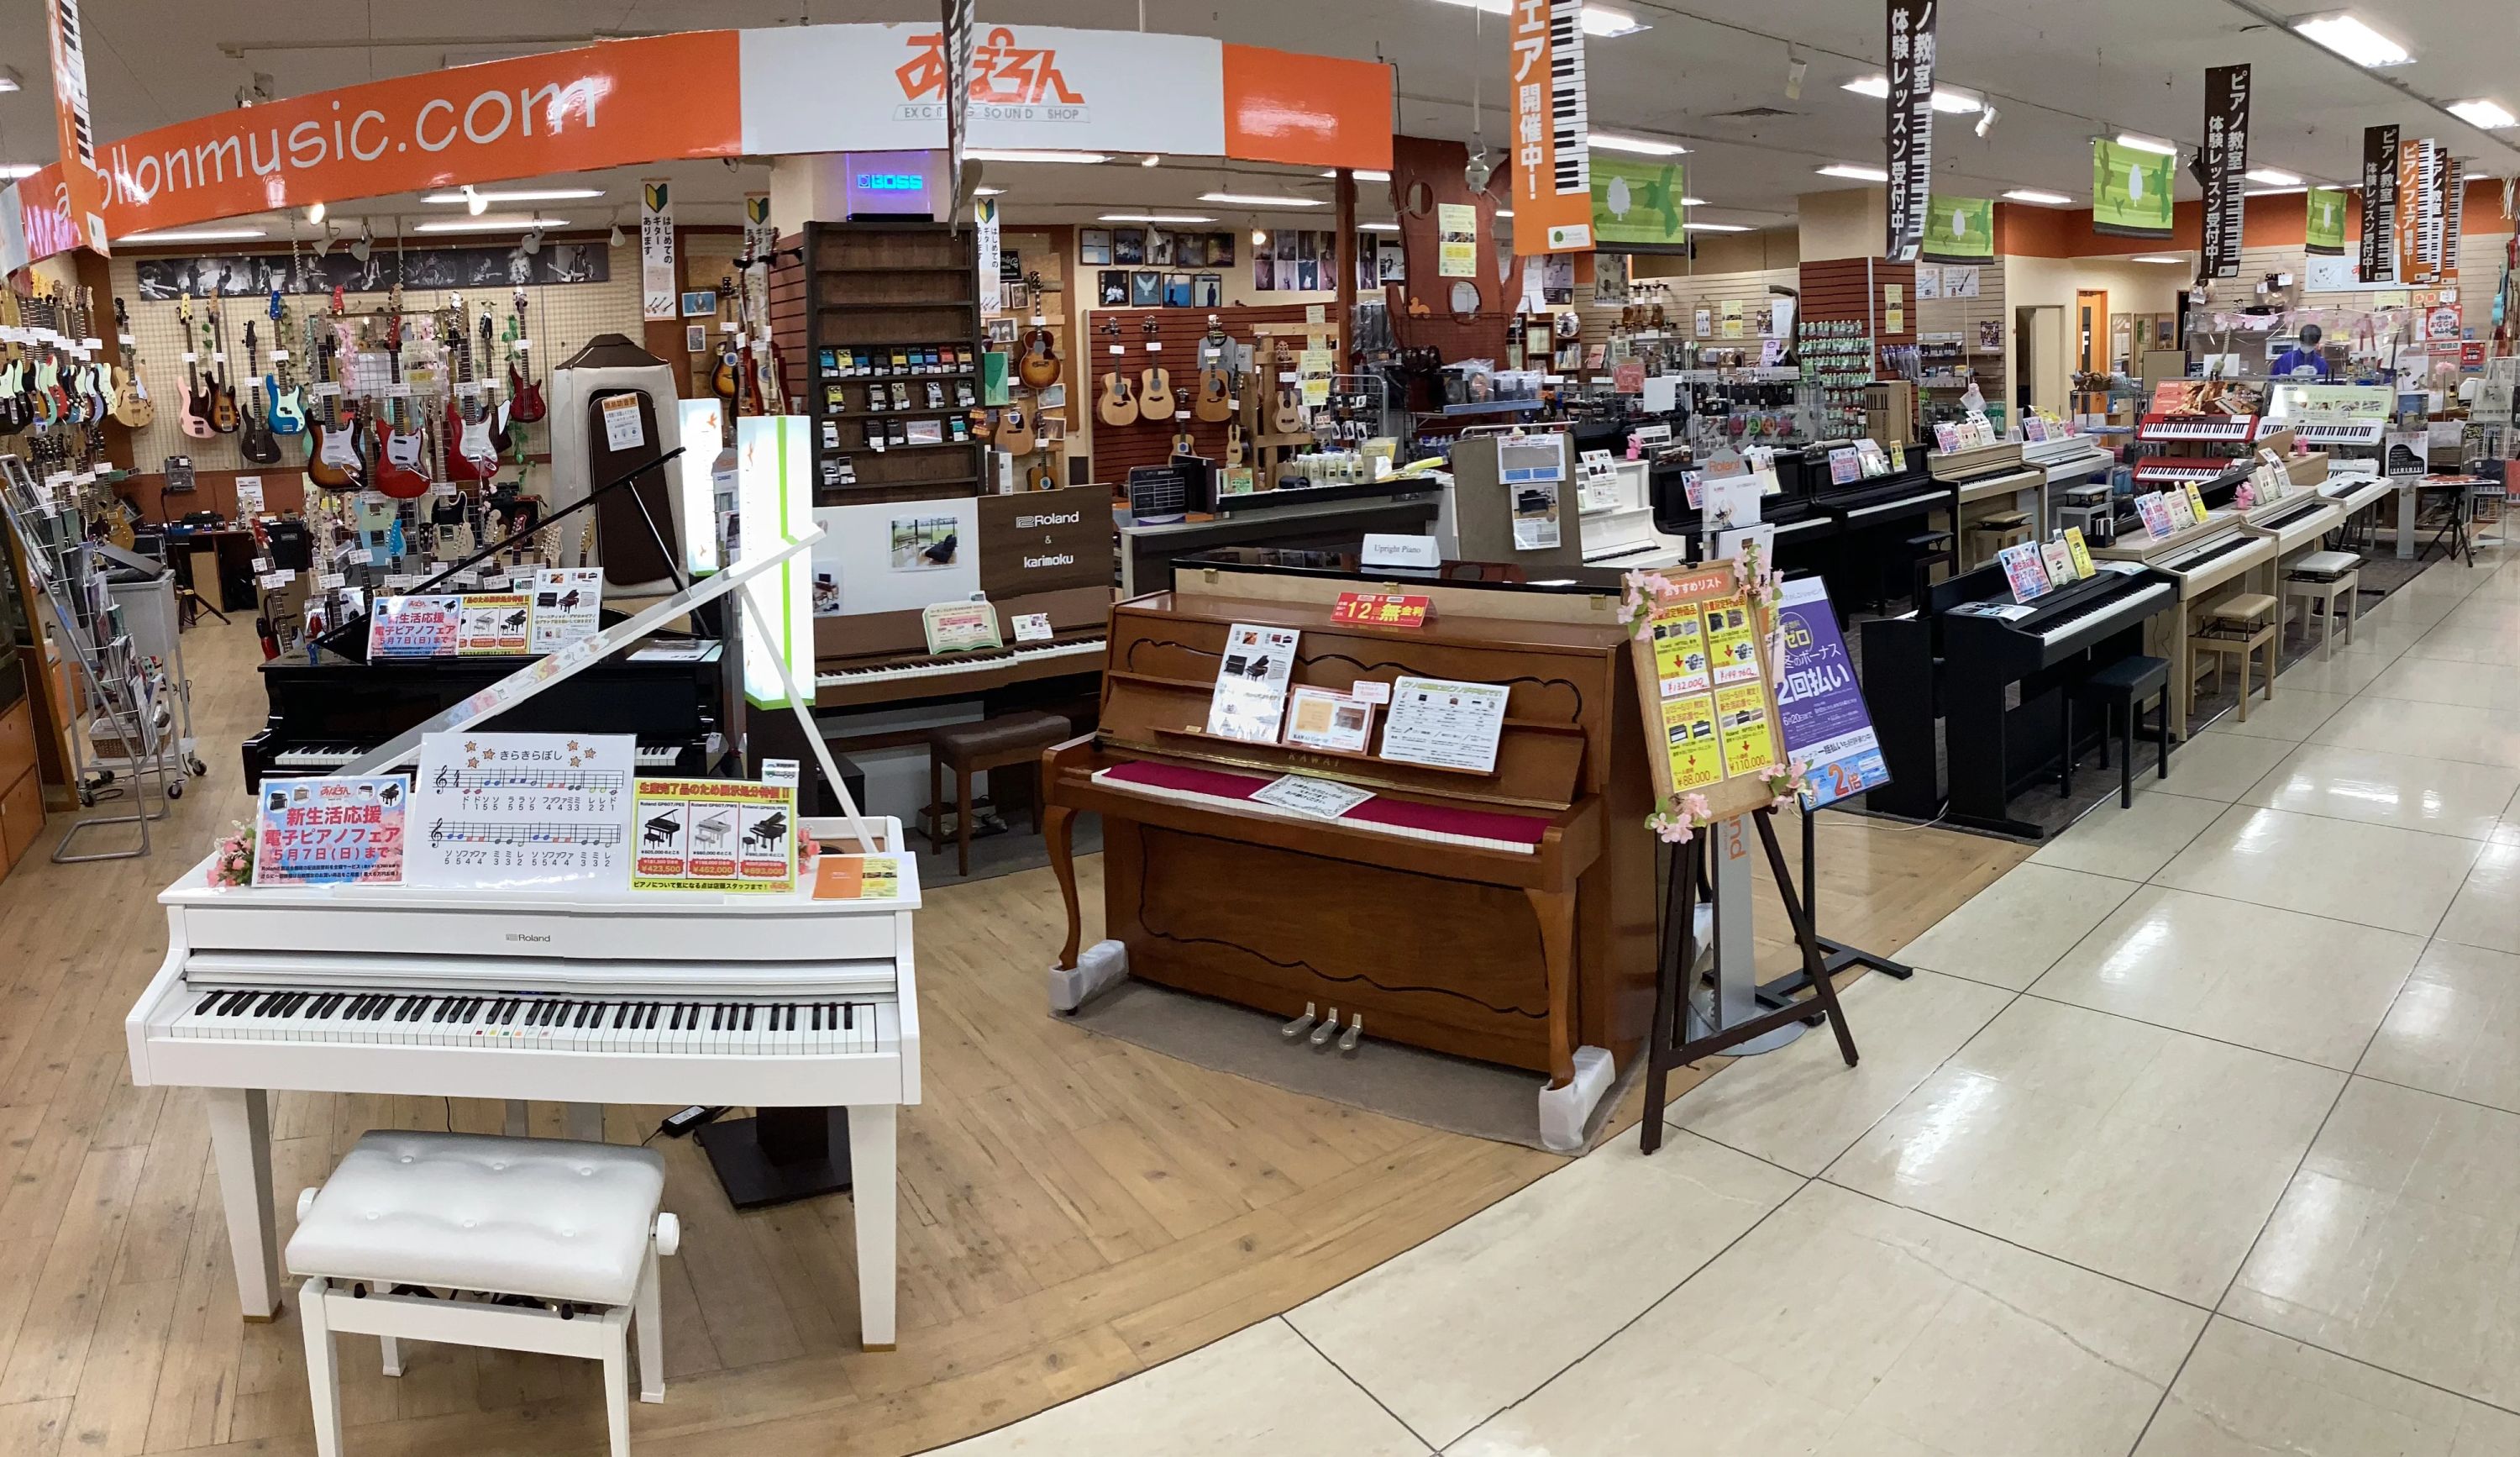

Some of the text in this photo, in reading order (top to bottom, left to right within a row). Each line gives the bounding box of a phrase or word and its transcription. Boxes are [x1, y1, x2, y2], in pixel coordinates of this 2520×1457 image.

[1913, 2, 1935, 95] ノ教室
[905, 107, 1079, 119] EXCITG SOUND SHOP
[2227, 70, 2248, 170] ピアノ教室
[1890, 8, 1909, 256] 体験レッスン受付中！
[55, 76, 596, 221] aollonmusic.com
[2379, 129, 2397, 203] ピアノ教室
[872, 175, 922, 189] BOSS
[2206, 116, 2224, 275] 体験レッスン受付中！
[653, 216, 662, 245] ギター
[663, 216, 673, 264] はじめての
[990, 228, 999, 268] はじめての
[1709, 459, 1740, 472] Roland
[1035, 512, 1079, 527] Roland
[1045, 535, 1052, 544] &
[1374, 544, 1399, 553] Upright
[1024, 553, 1074, 568] karimoku
[375, 625, 456, 636] 電子ピアノフェア
[1785, 629, 1811, 649] ゼロ
[1777, 663, 1850, 706] 2回払い
[500, 750, 563, 760] きらきらぼし
[1289, 752, 1340, 766] KAWAI
[320, 784, 351, 797] あぽろん
[286, 805, 381, 826] 新生活応援
[265, 827, 401, 847] 電子ピアノフェア
[641, 865, 681, 874] ¥423,500
[518, 934, 551, 942] Roland
